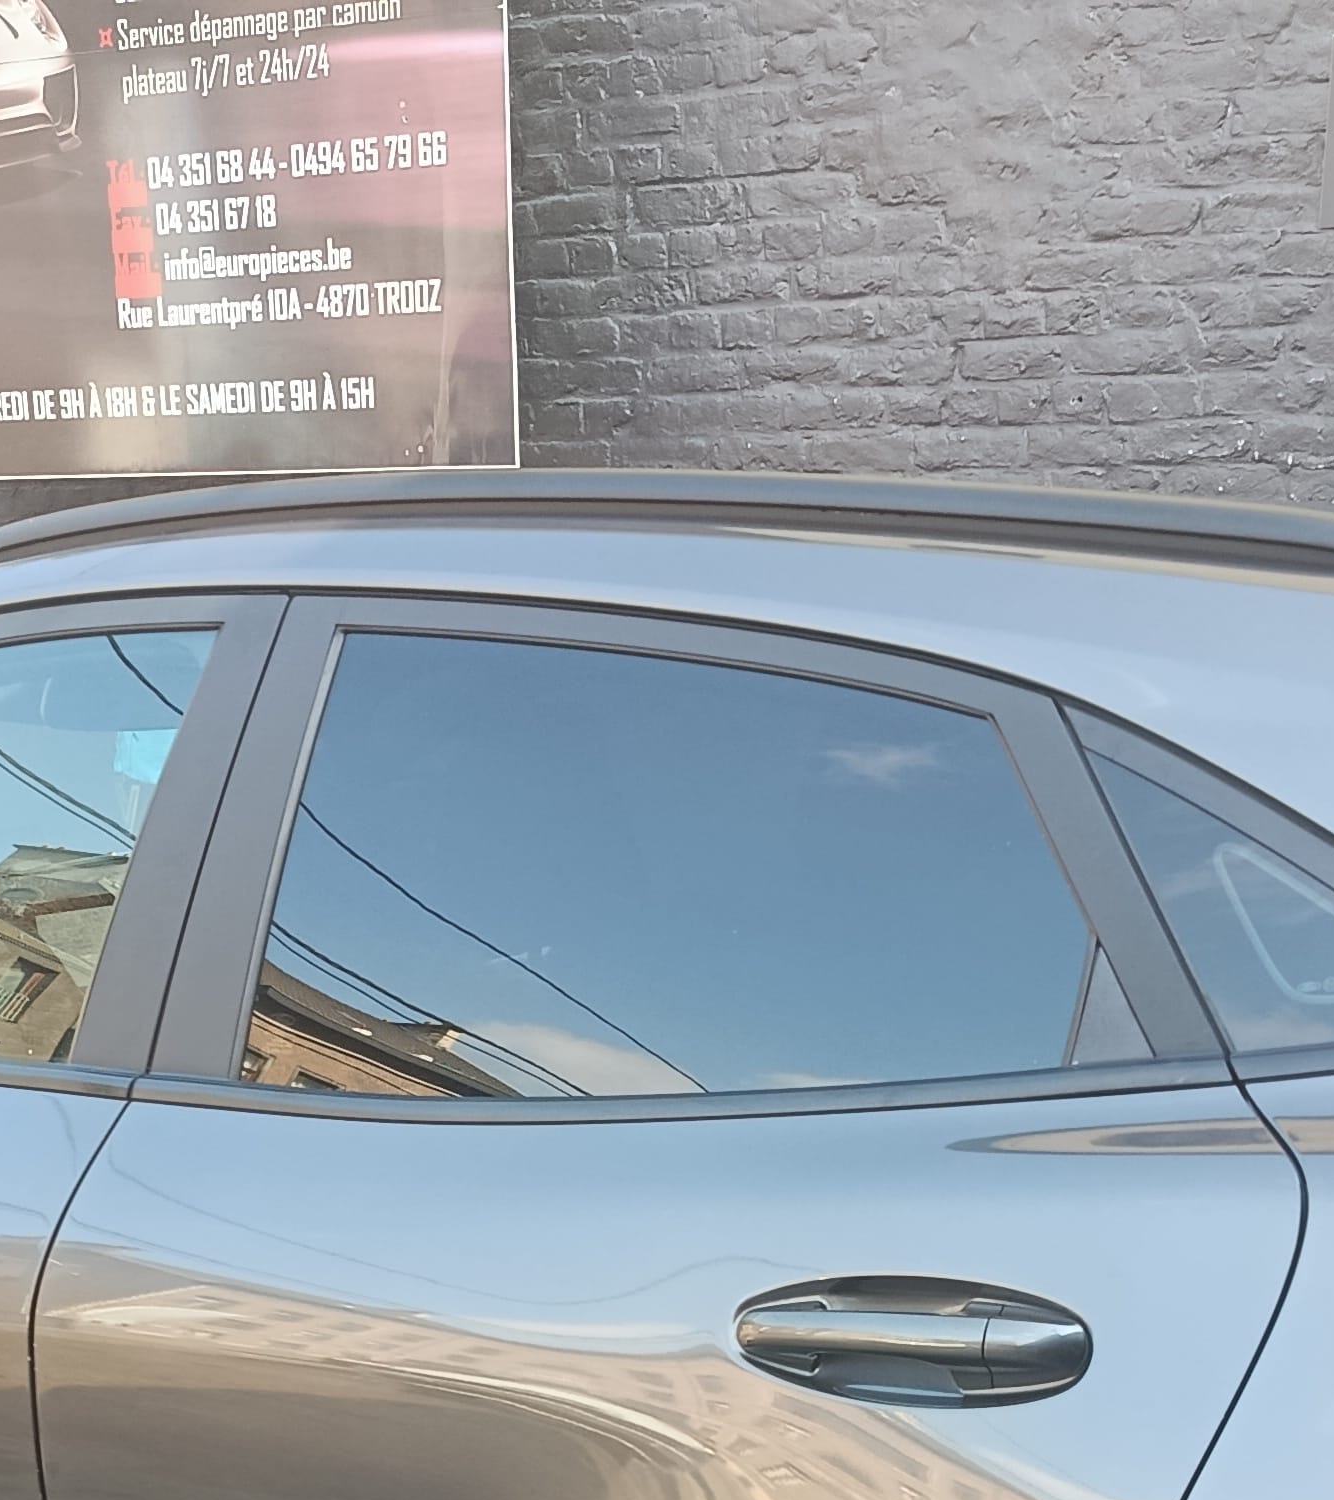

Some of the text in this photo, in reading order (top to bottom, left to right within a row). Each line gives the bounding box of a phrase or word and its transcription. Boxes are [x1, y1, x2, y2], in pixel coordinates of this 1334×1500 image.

[117, 0, 401, 51] Service dépannage par camion
[122, 43, 329, 104] plateau 7j/7 et 24h/24
[146, 156, 174, 190] 04
[178, 152, 211, 188] 351
[216, 148, 244, 184] 68
[248, 146, 276, 181] 44
[290, 140, 346, 178] 0494
[351, 137, 379, 174] 65
[384, 134, 412, 170] 79
[418, 131, 447, 167] 66
[155, 201, 182, 236] 04
[186, 198, 220, 234] 351
[224, 196, 249, 231] 67
[255, 194, 277, 229] 18
[164, 237, 352, 282] info@europieces.be
[118, 297, 153, 330] Rue
[157, 291, 264, 330] Laurentpré
[267, 287, 302, 322] 10A
[316, 283, 369, 318] 4870
[374, 278, 442, 316] TROOZ
[32, 389, 57, 420] DE
[60, 388, 85, 419] 9H
[88, 381, 103, 418] À
[105, 386, 138, 418] 18H
[159, 384, 182, 416] LE
[185, 381, 255, 415] SAMEDI
[260, 380, 285, 413] DE
[290, 379, 317, 411] 9H
[322, 371, 336, 411] À
[340, 376, 375, 410] 15H
